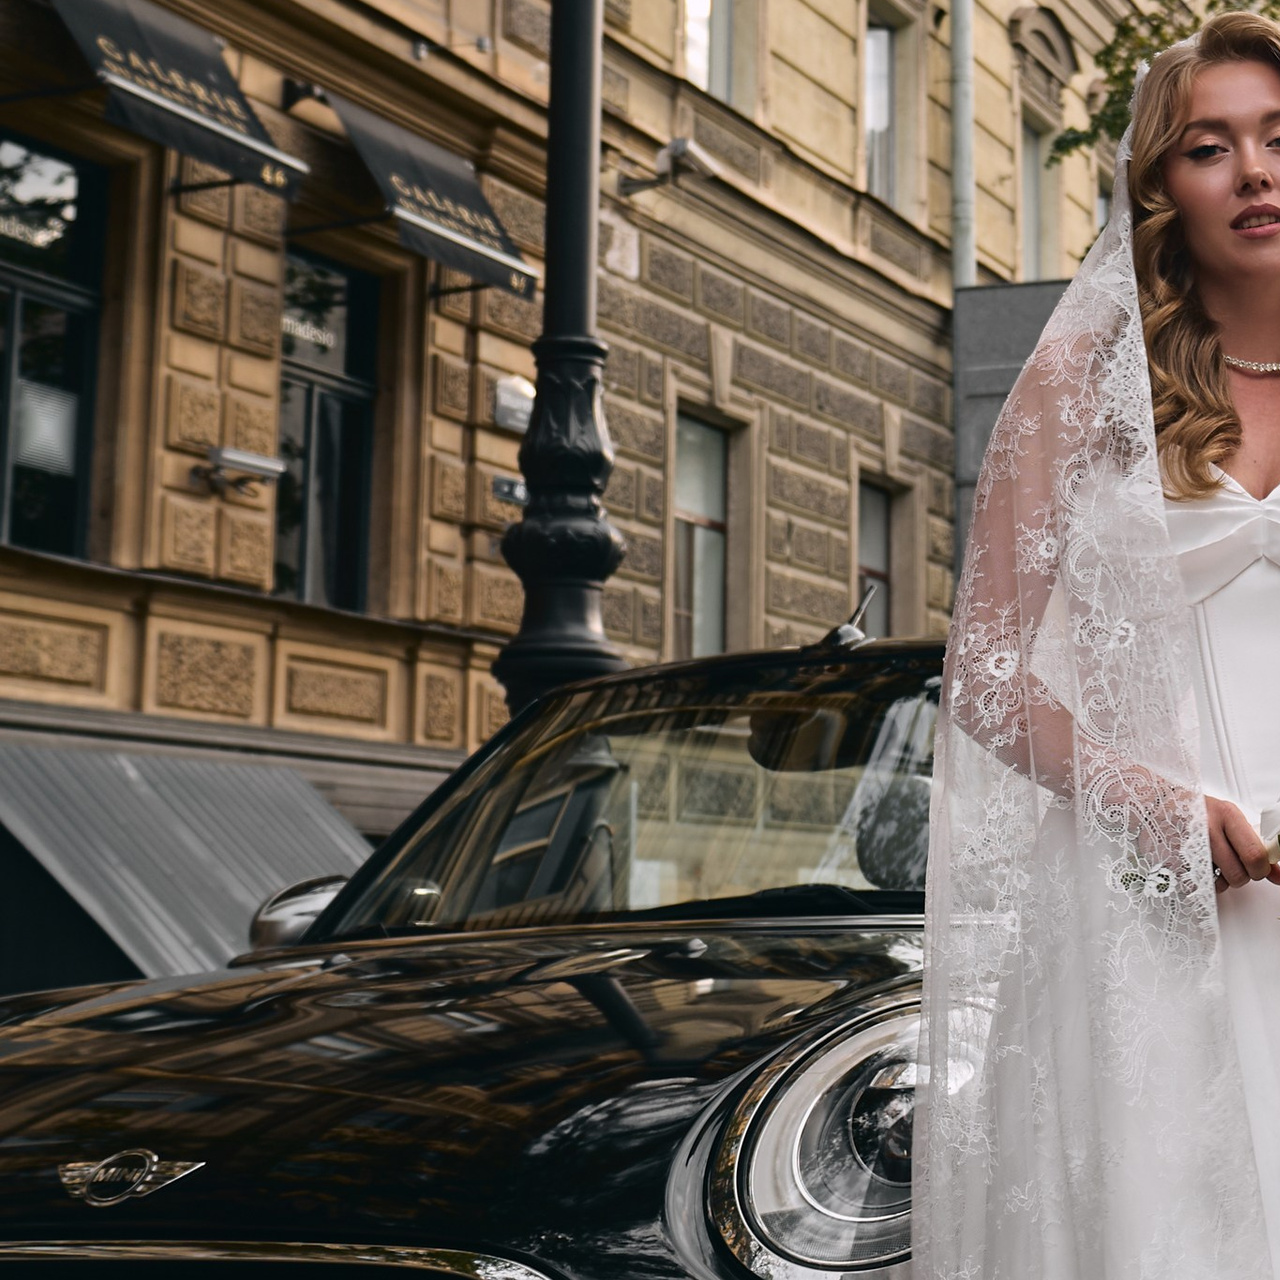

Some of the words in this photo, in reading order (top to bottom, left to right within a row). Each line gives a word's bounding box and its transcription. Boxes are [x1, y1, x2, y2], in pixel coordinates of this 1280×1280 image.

[97, 35, 247, 121] GALERIE
[390, 173, 501, 238] GALERIE
[92, 1167, 143, 1183] MINI
